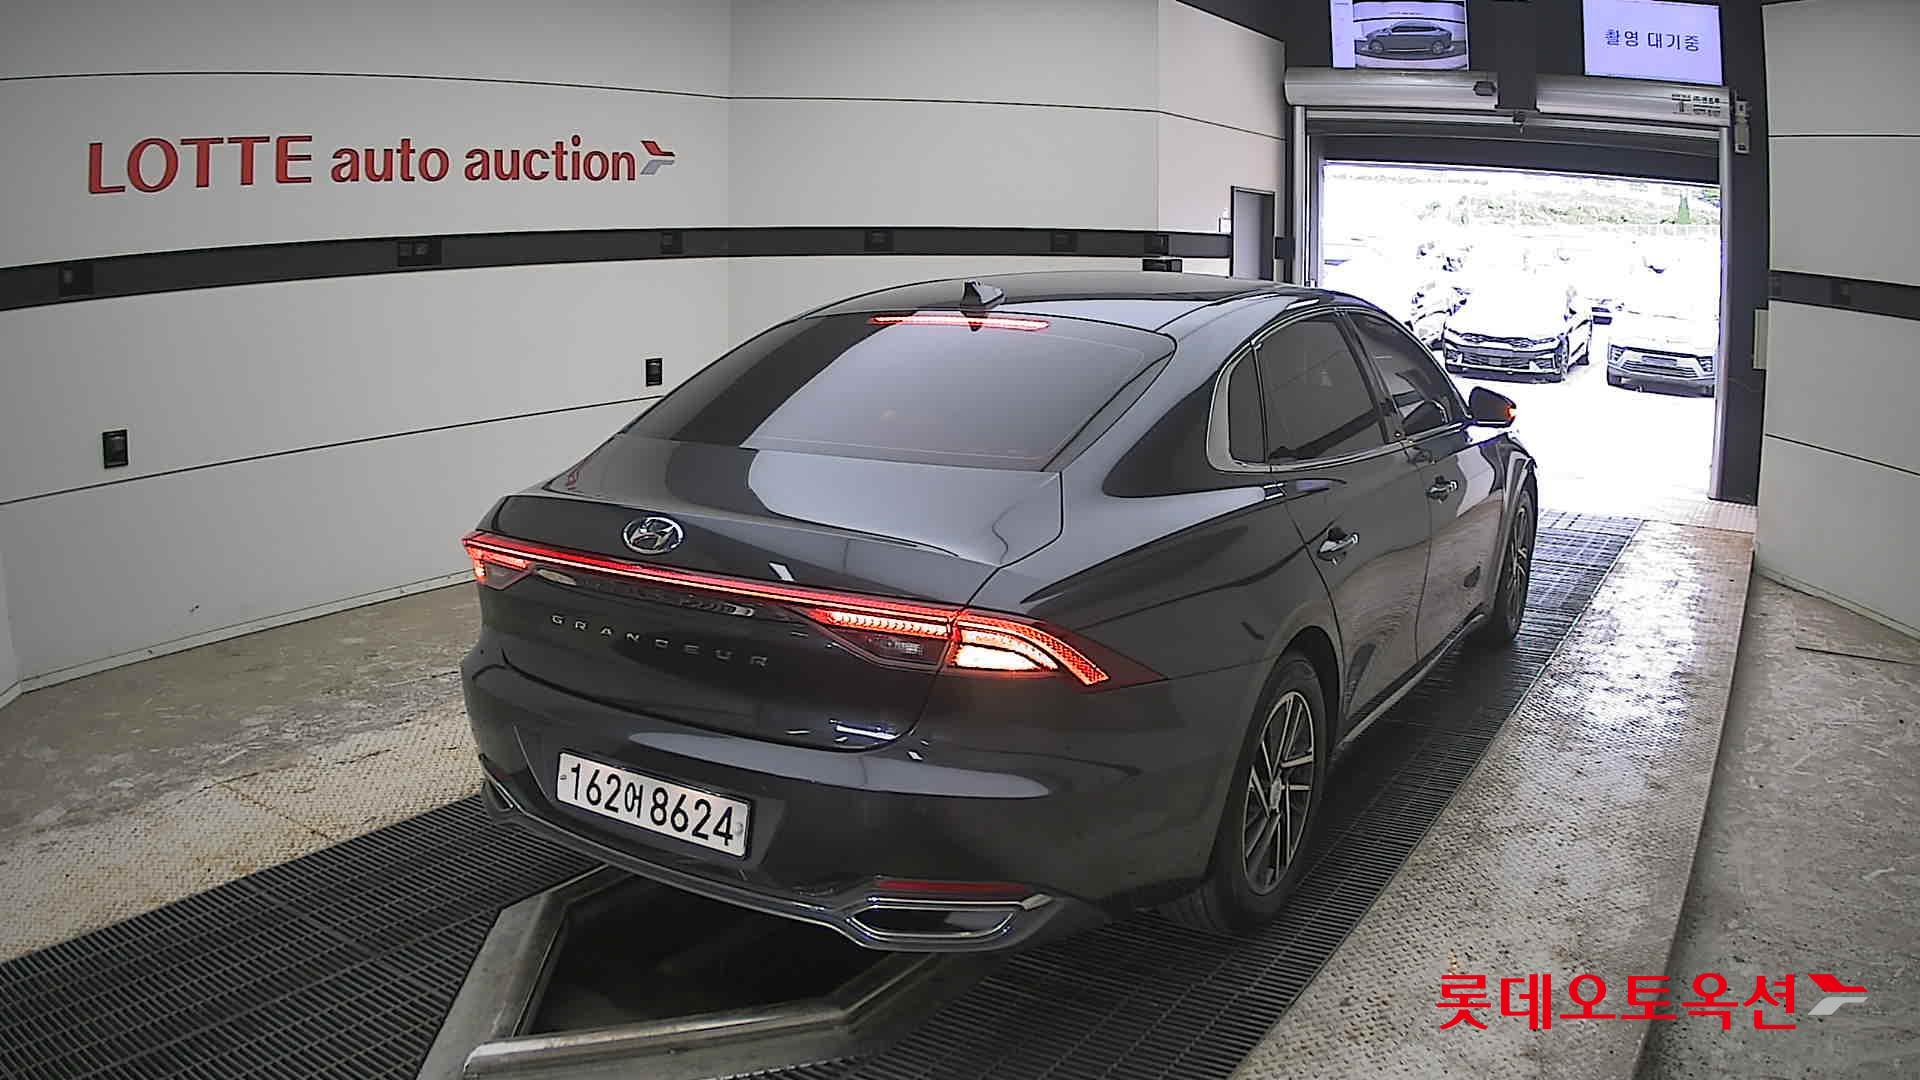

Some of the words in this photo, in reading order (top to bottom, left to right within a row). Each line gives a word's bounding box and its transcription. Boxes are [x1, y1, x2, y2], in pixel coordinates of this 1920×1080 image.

[1604, 29, 1639, 47] 촬영
[1647, 32, 1699, 51] 대기중
[88, 136, 313, 194] LOTTE
[330, 138, 450, 182] auto
[464, 134, 636, 181] auction
[552, 615, 768, 666] GRANDEUR
